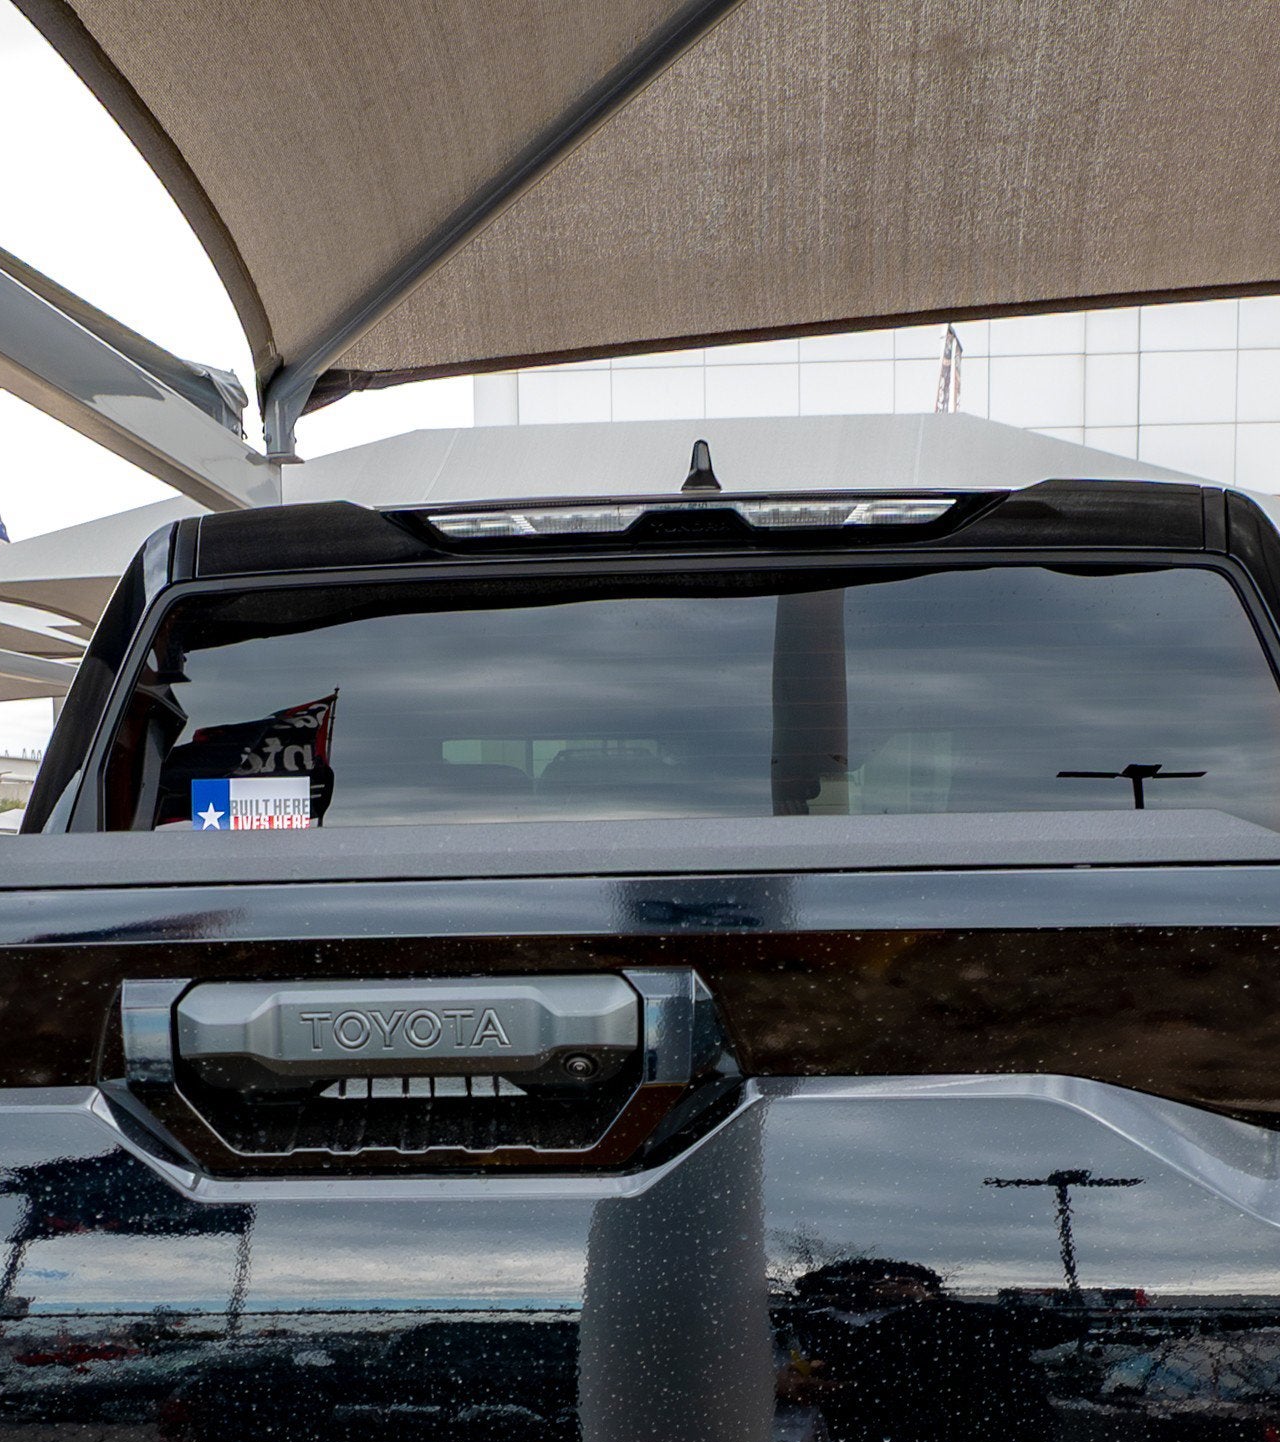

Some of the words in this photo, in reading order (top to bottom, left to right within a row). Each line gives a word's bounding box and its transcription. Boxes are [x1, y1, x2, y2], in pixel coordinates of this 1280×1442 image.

[230, 799, 270, 816] BUILT
[273, 798, 309, 815] HERE
[299, 1008, 511, 1051] TOYOTA
